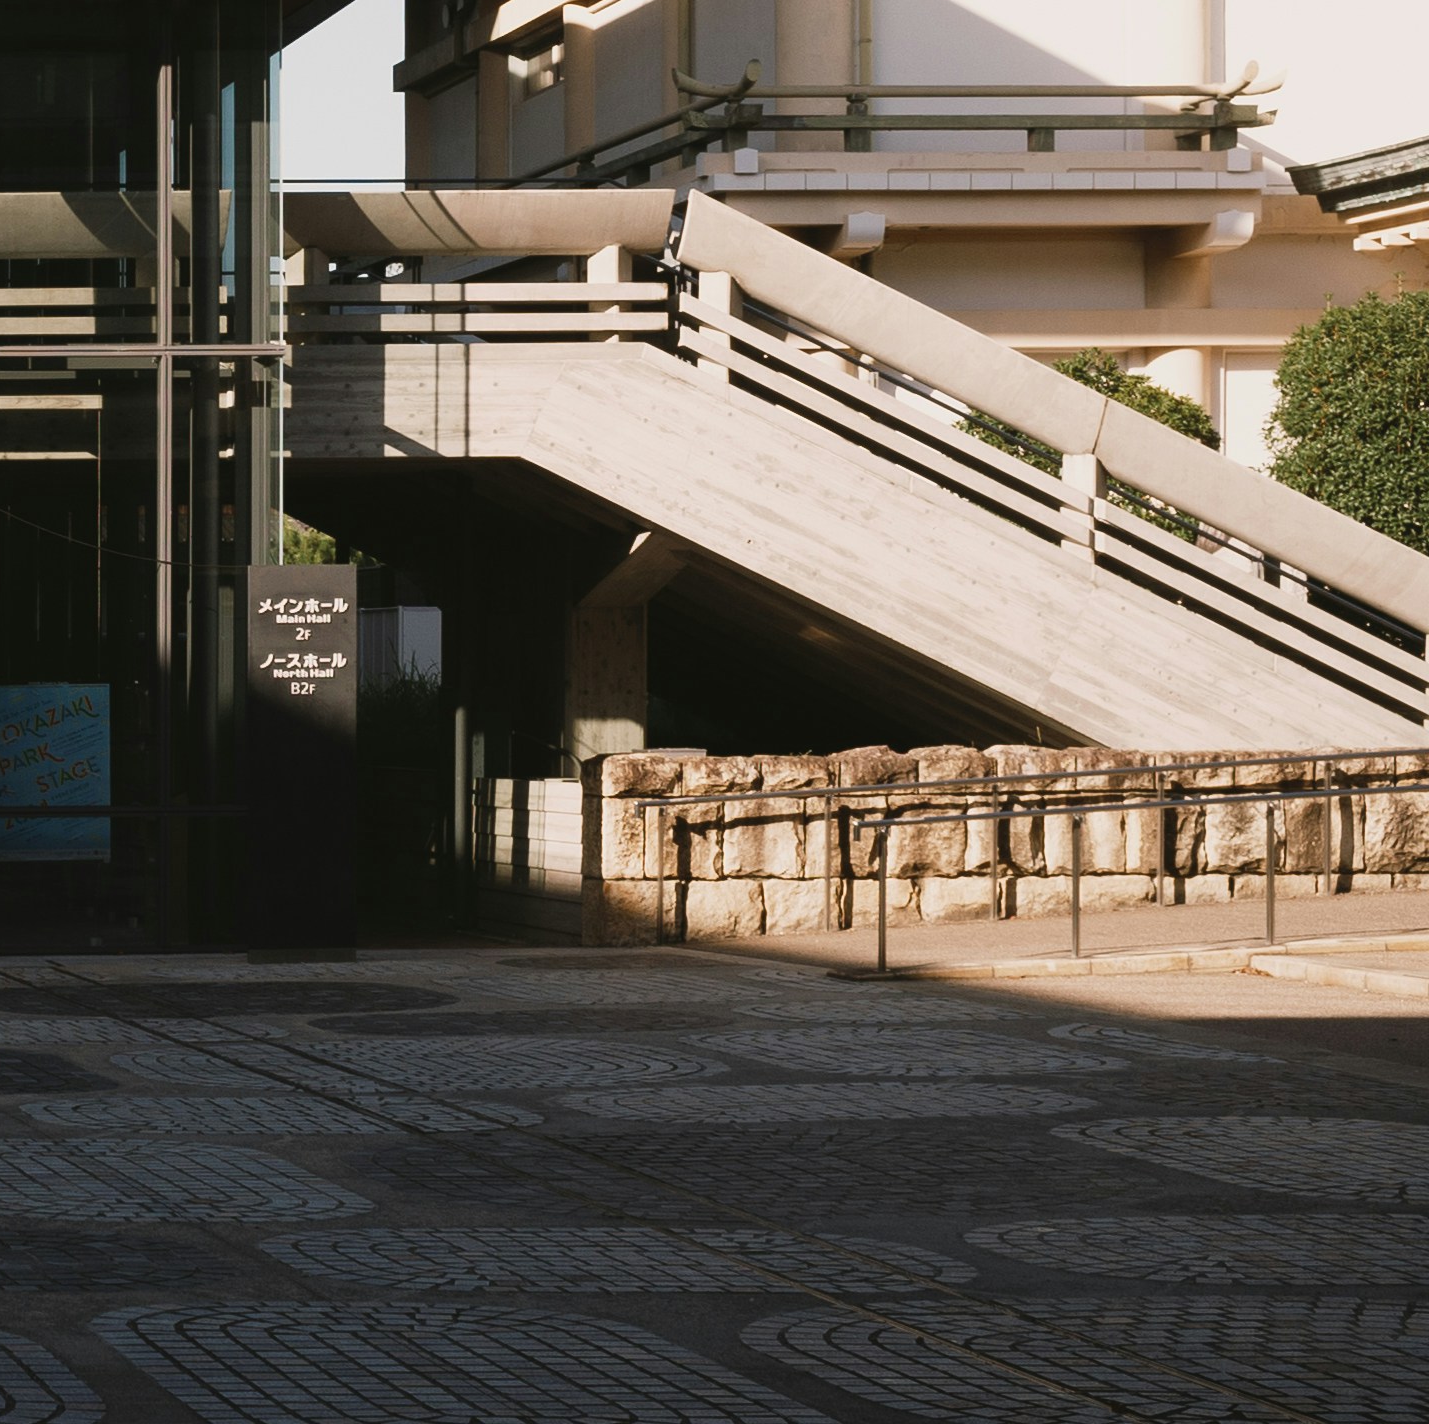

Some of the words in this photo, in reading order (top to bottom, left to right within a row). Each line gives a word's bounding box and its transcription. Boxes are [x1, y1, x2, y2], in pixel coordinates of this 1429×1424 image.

[258, 598, 349, 614] メインホール
[275, 614, 306, 624] Main
[306, 613, 331, 624] Hall
[295, 627, 312, 641] 2F
[259, 653, 347, 669] ノースホール
[273, 669, 309, 678] North
[309, 668, 334, 678] Hall
[290, 682, 316, 695] B2F
[2, 695, 100, 744] OKAZAKI
[35, 755, 101, 793] STAGE
